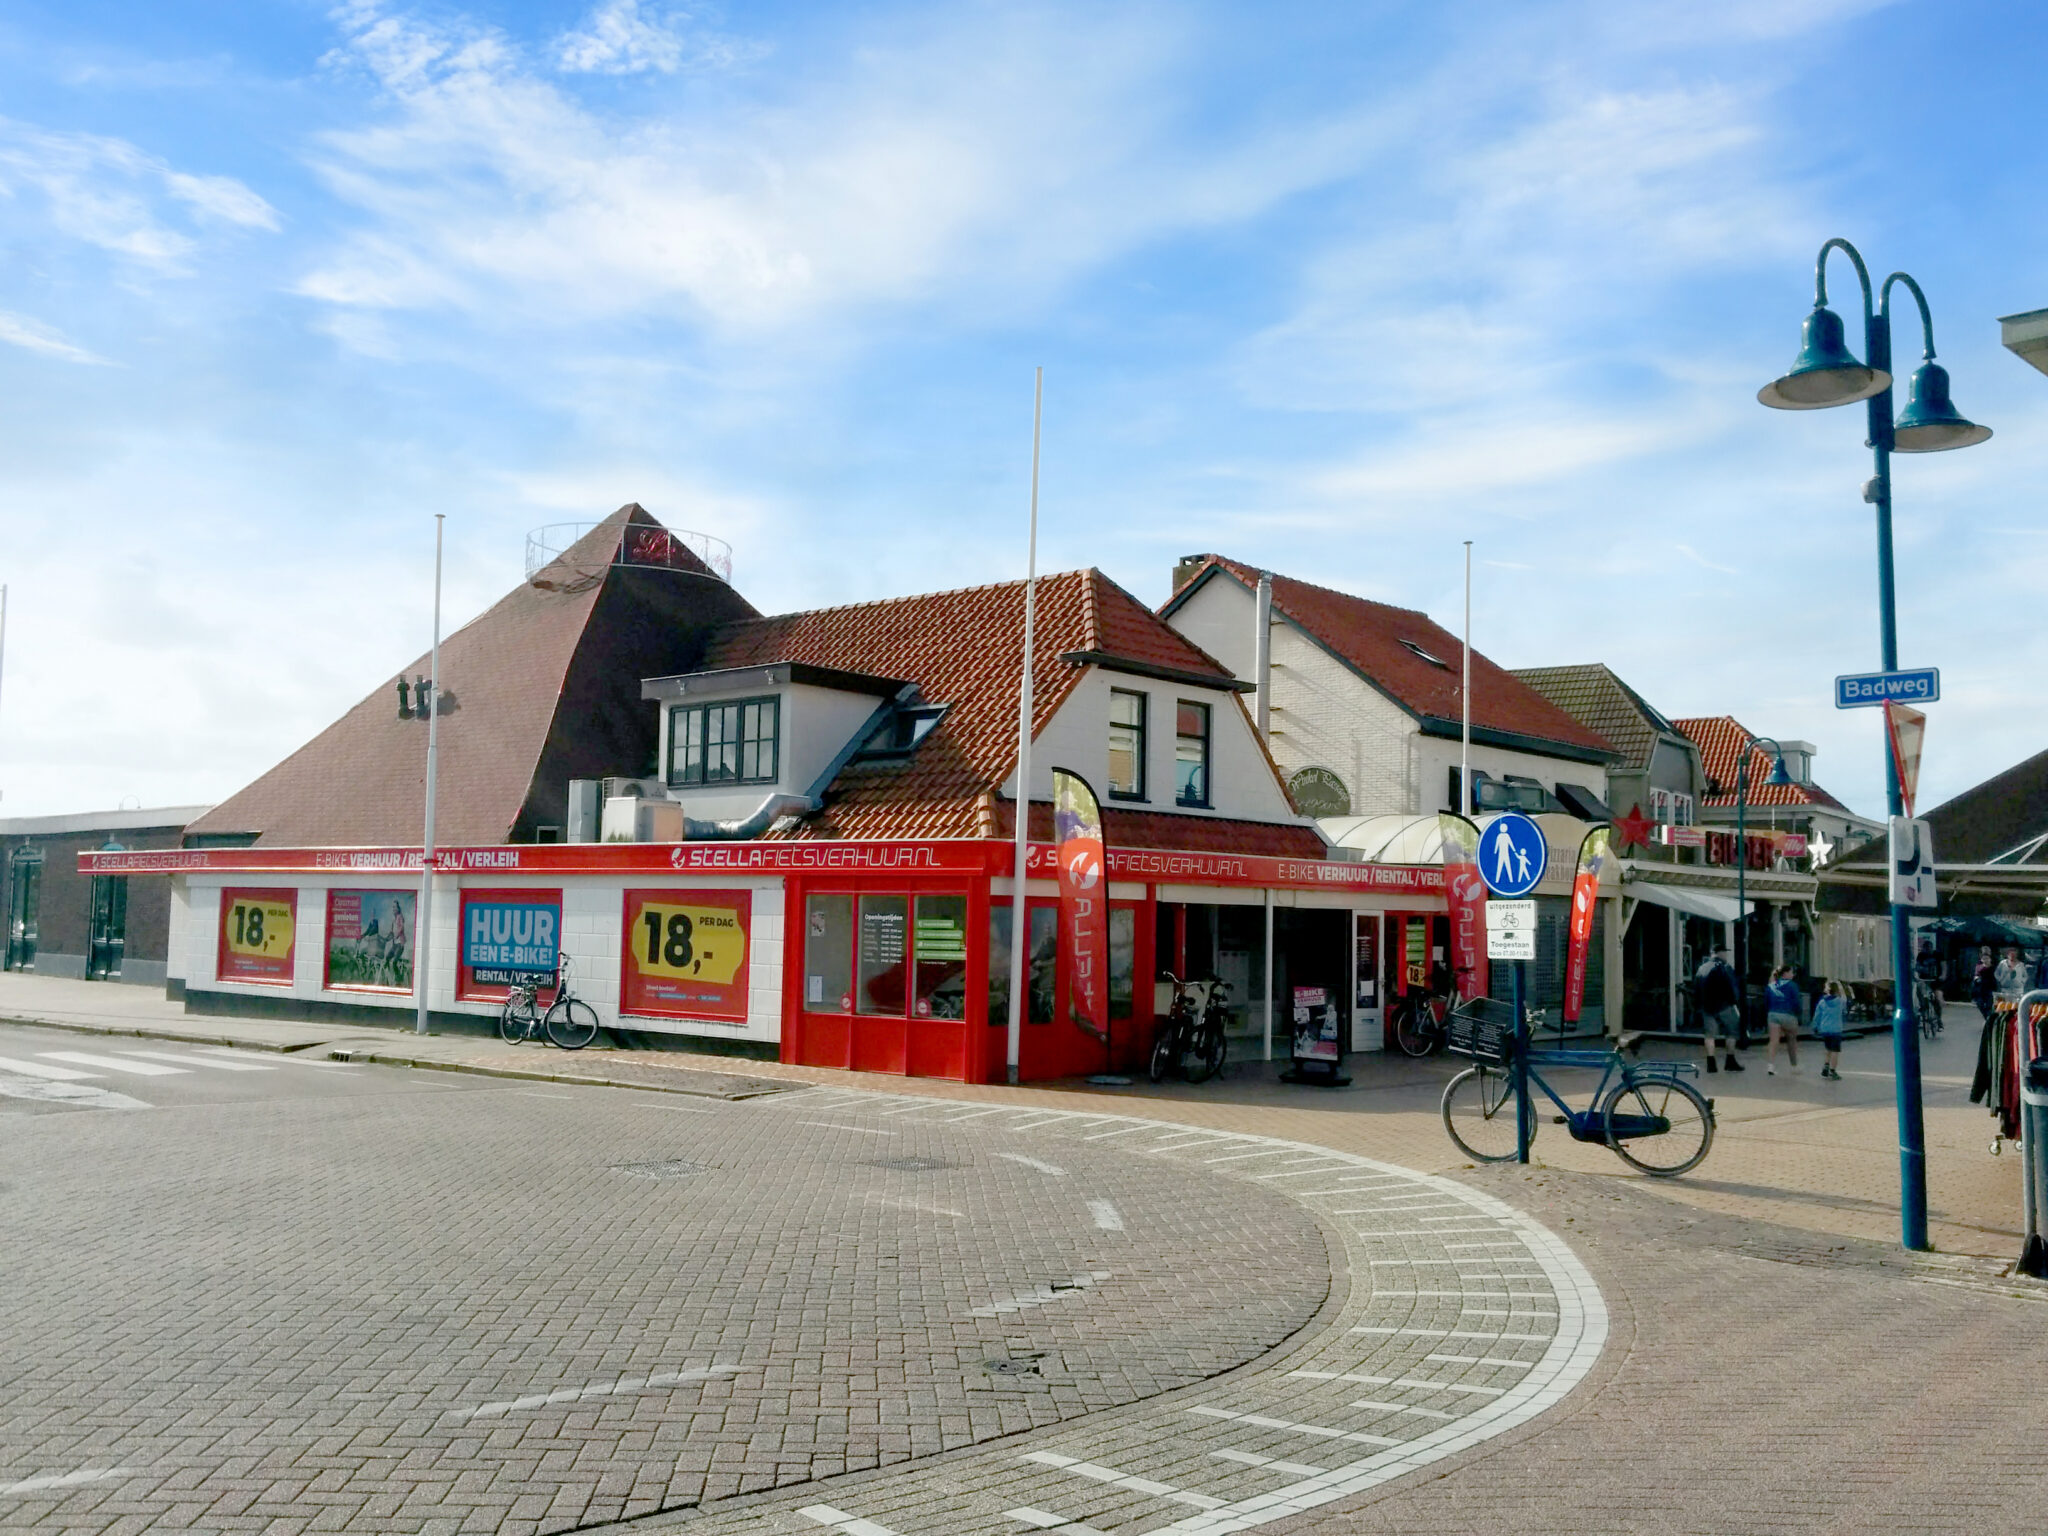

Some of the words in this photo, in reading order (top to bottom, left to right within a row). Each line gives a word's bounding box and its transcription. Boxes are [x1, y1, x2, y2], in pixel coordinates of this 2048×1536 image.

[1845, 678, 1928, 697] Badweg
[316, 853, 347, 867] E-BIKE
[1278, 863, 1314, 880] E-BIKE
[471, 908, 553, 946] HUUR
[699, 916, 715, 926] PER
[716, 918, 734, 928] DAG
[1491, 941, 1530, 949] Toegestaan
[470, 944, 498, 962] EEN
[500, 946, 553, 966] E-BIKE!
